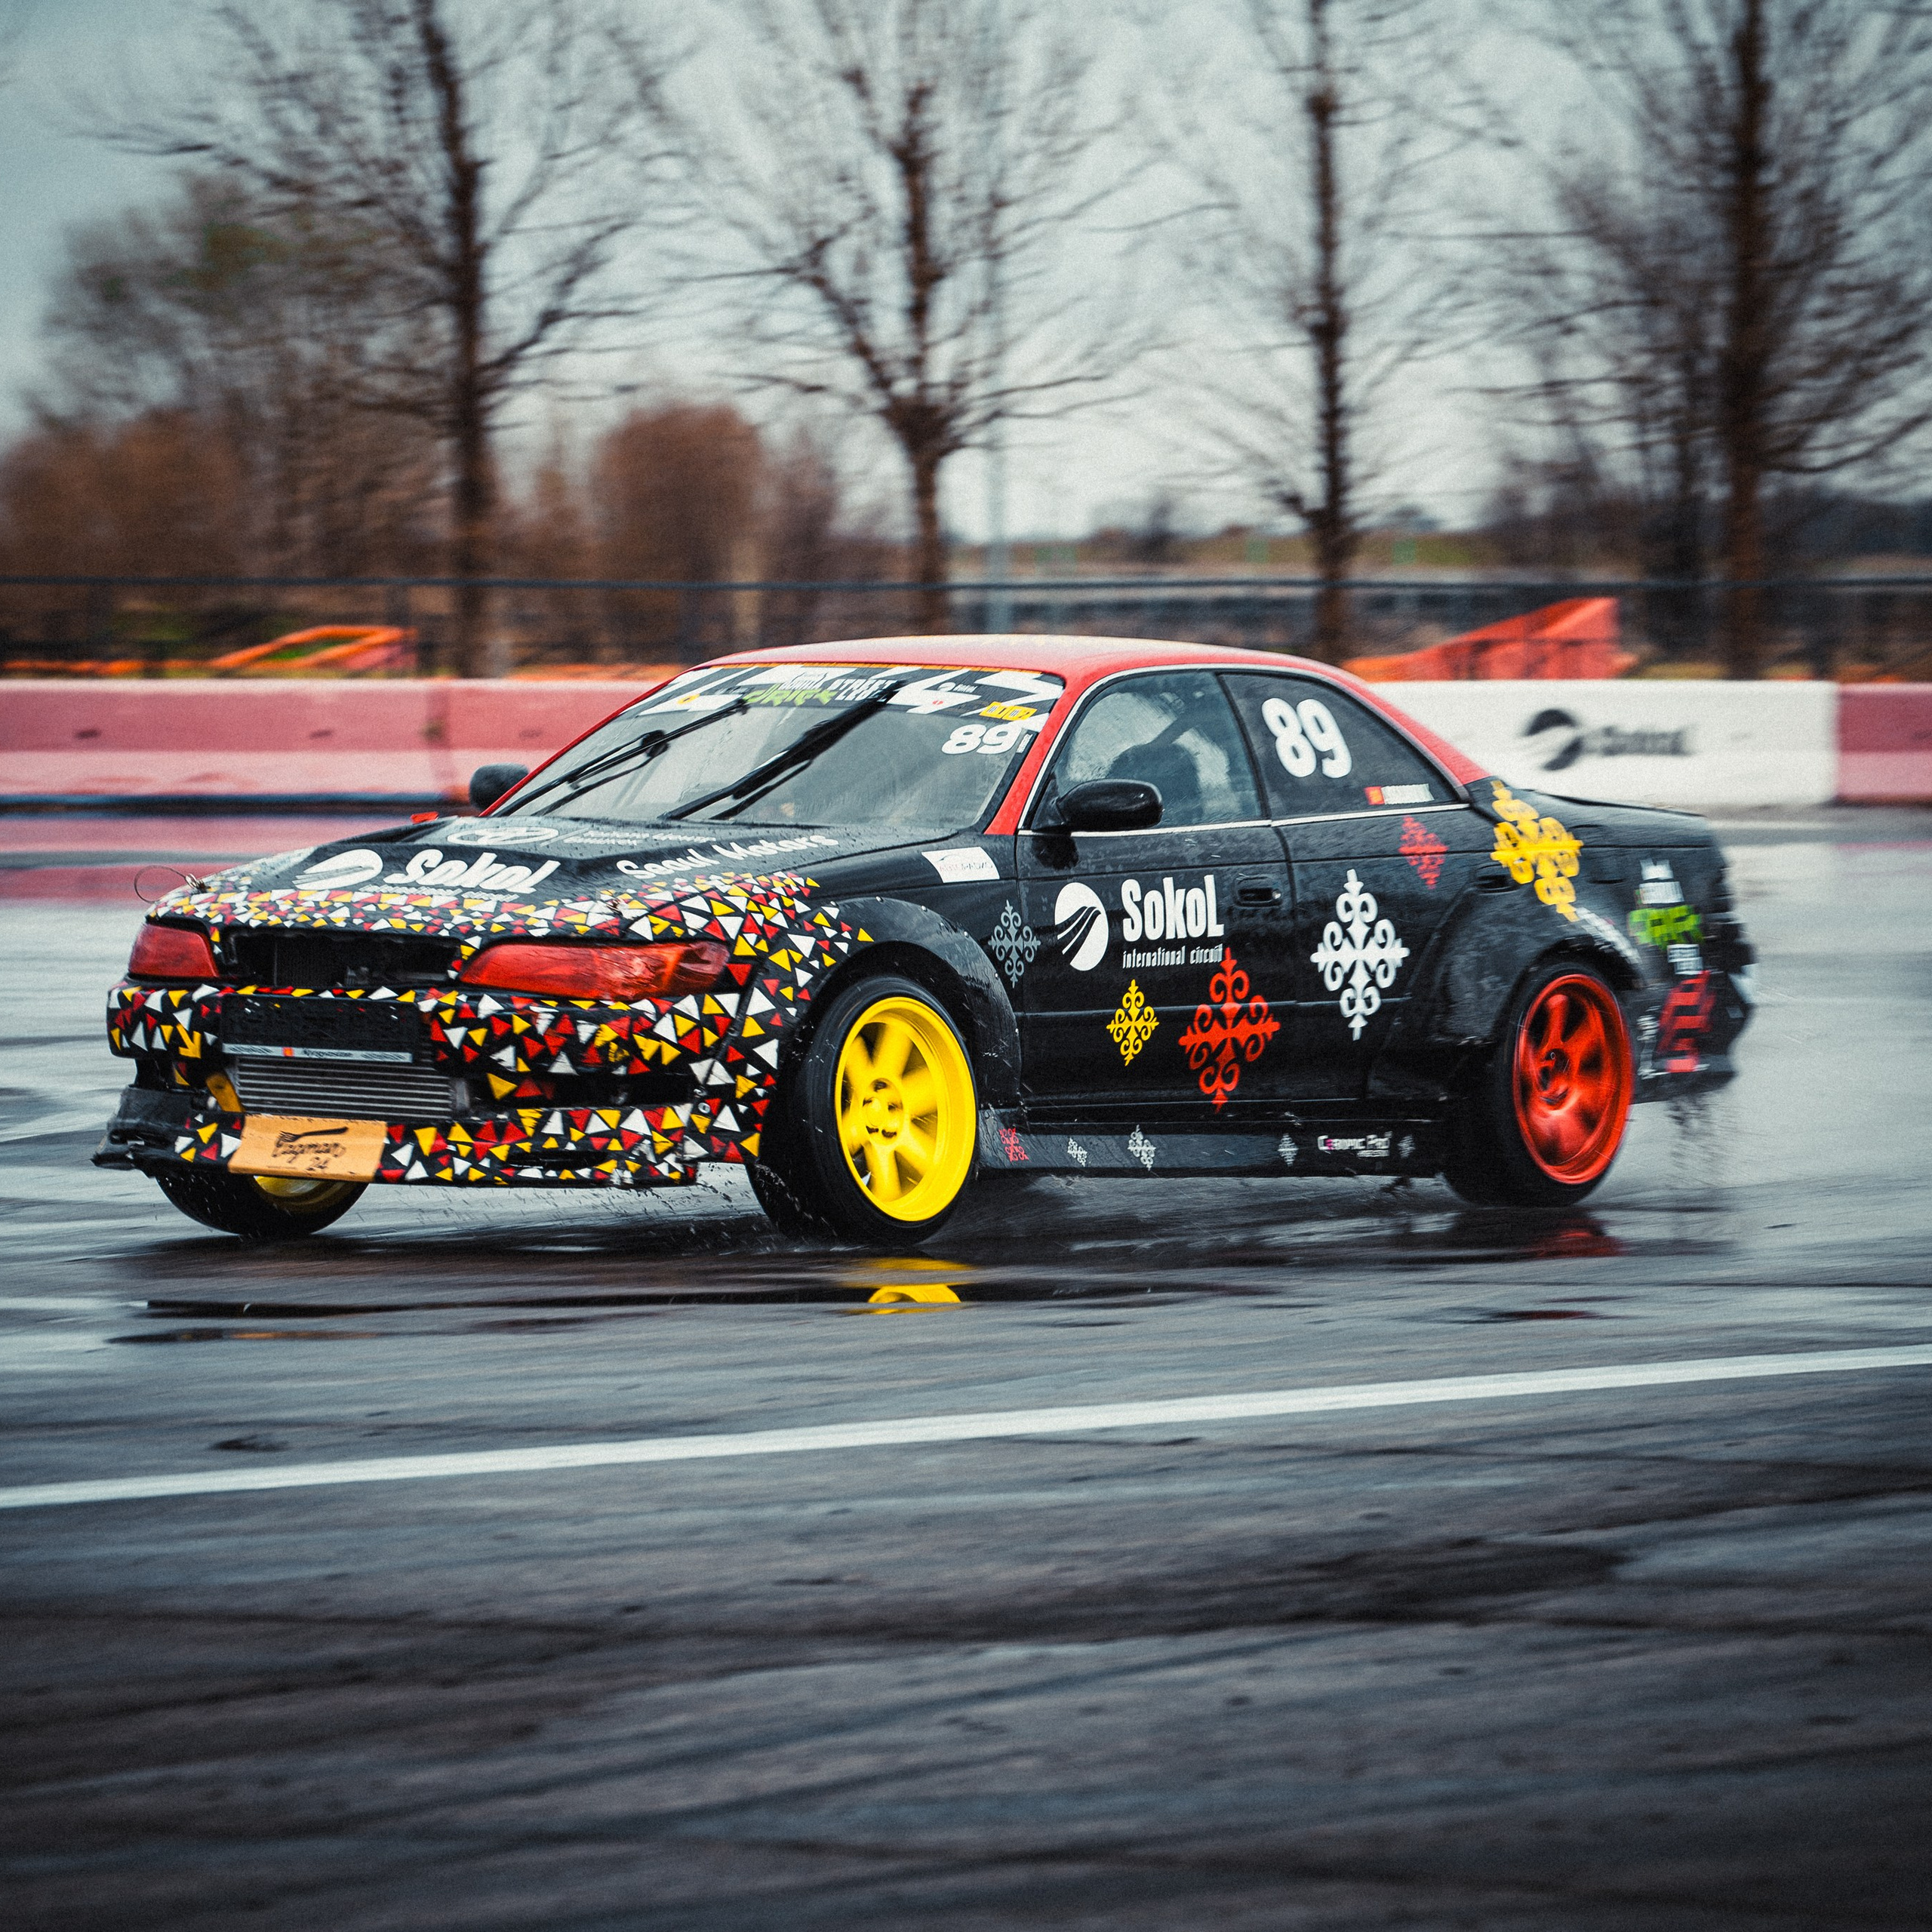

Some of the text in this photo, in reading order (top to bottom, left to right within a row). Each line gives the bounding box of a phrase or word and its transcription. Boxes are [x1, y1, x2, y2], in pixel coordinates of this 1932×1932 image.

[826, 678, 898, 691] STREET
[941, 724, 1022, 755] 89
[1261, 697, 1352, 779] 89
[615, 848, 721, 879] Seoul
[711, 834, 839, 861] Motors
[1122, 943, 1223, 969] international circuit
